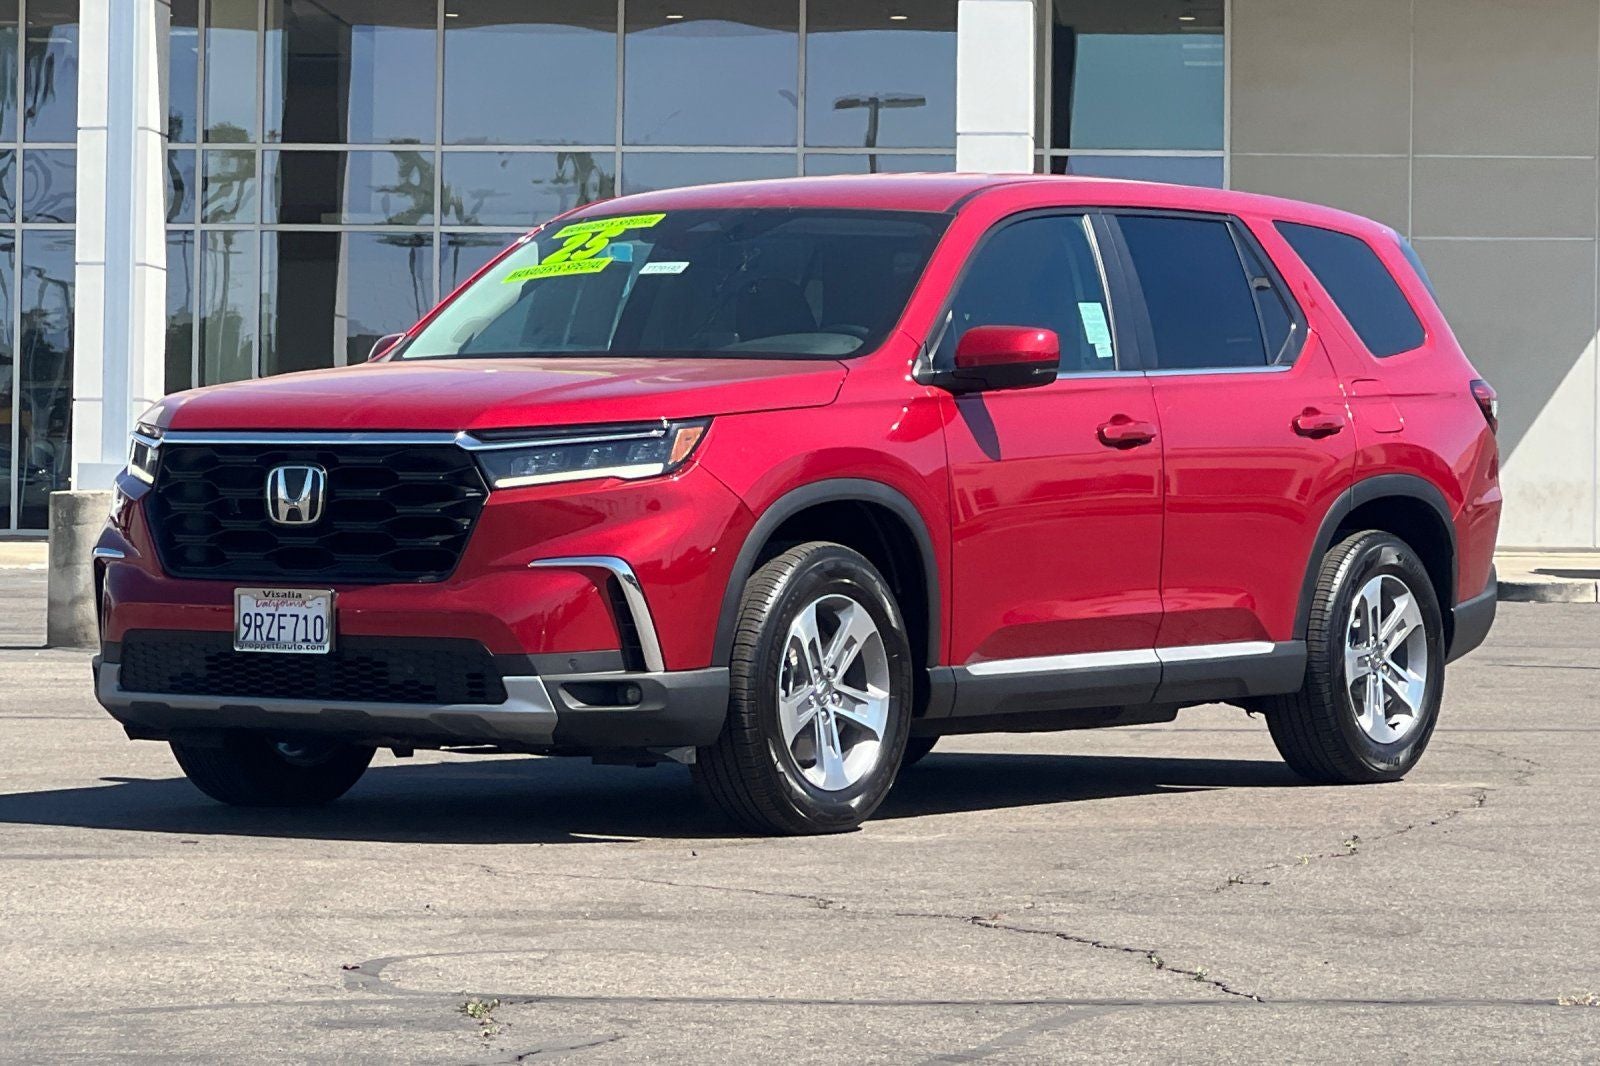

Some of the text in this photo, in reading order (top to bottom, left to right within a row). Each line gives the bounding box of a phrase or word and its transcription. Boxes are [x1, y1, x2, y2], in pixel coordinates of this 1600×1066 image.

[262, 590, 302, 599] Visalia
[242, 612, 324, 643] 9RZF710
[240, 642, 325, 651] groppettiauto.com
